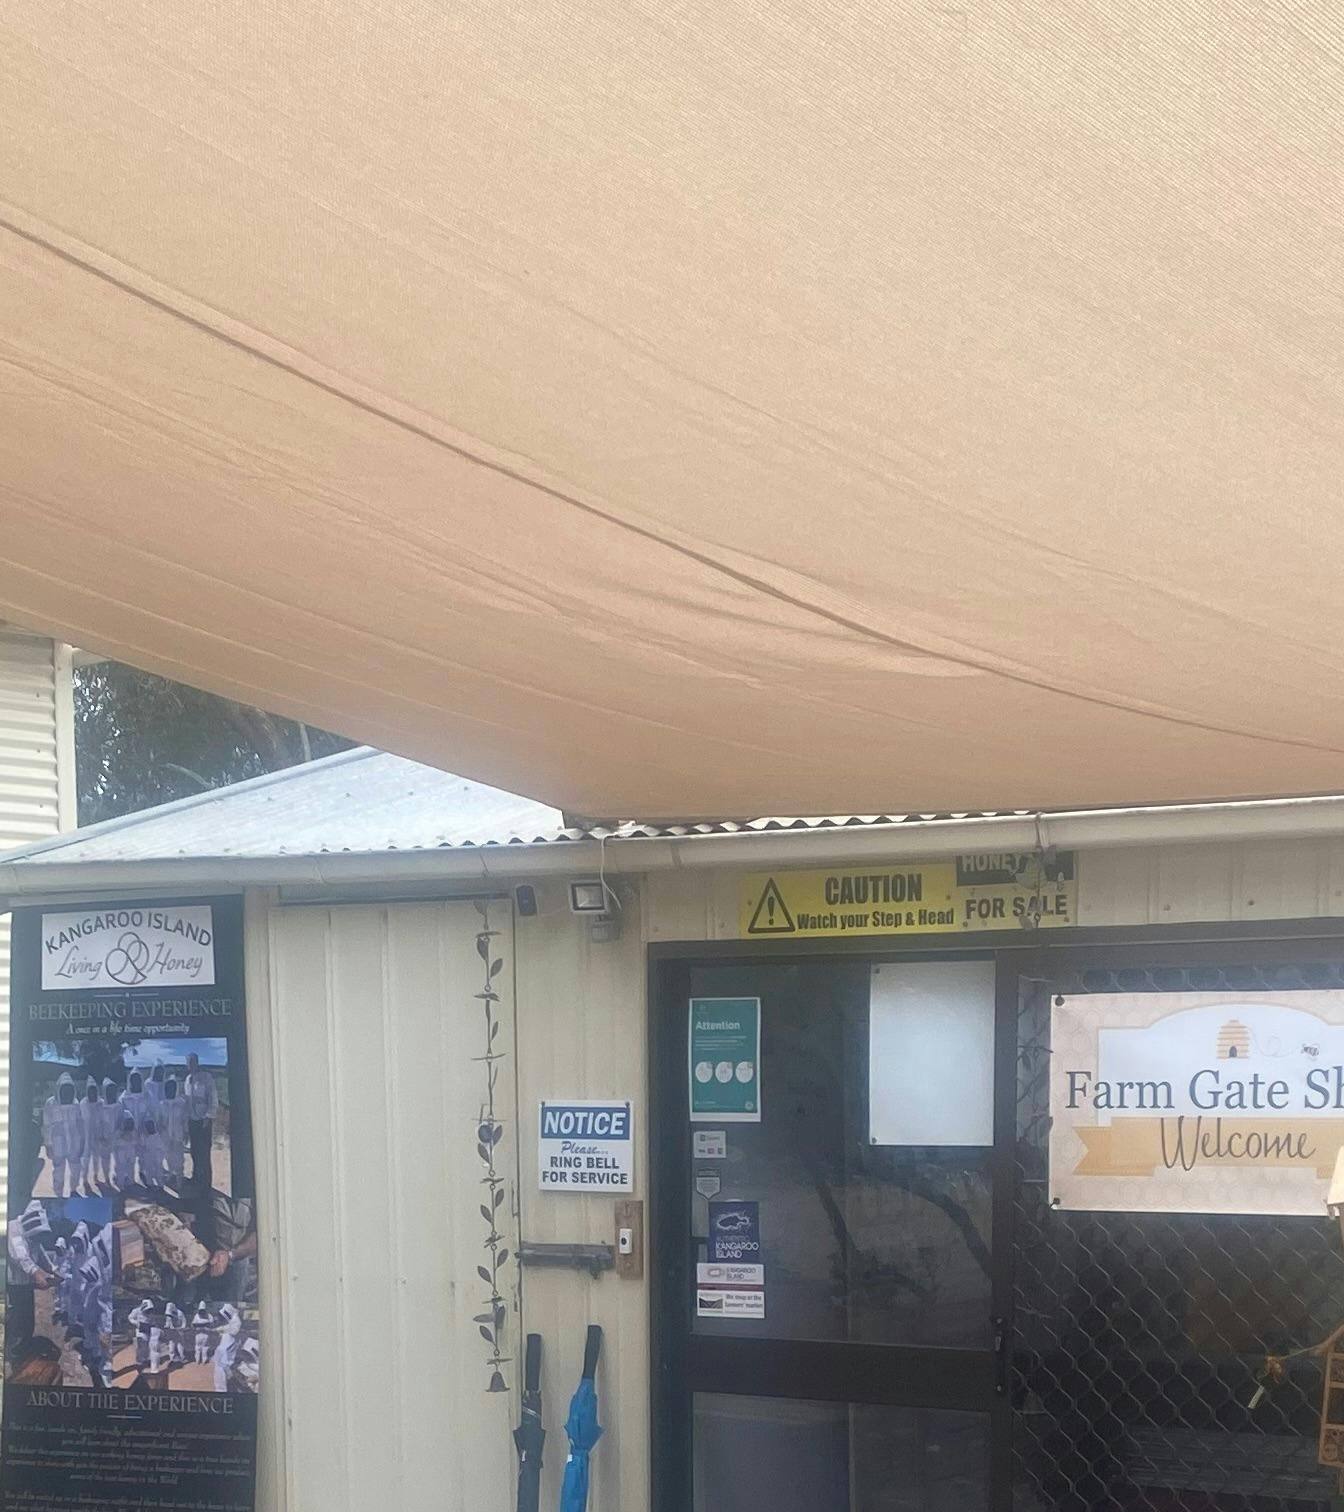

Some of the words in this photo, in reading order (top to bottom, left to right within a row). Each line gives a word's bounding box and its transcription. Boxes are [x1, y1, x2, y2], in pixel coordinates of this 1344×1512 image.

[824, 872, 923, 906] CAUTION
[796, 912, 838, 931] Watch
[840, 912, 870, 930] your
[872, 910, 903, 929] Step
[905, 910, 917, 926] &
[918, 907, 955, 926] Head
[965, 896, 1006, 920] FOR
[1012, 894, 1068, 917] SALE
[45, 911, 143, 954] KANGAROO
[147, 912, 212, 947] ISLAND
[55, 945, 103, 981] Living
[146, 941, 204, 979] Honey
[28, 1002, 127, 1021] BEEKEEPING
[132, 999, 232, 1019] EXPERIENCE
[696, 1021, 741, 1031] Attention
[1064, 1069, 1176, 1109] Farm
[1188, 1068, 1290, 1110] Gate
[543, 1111, 627, 1135] NOTICE
[1159, 1114, 1317, 1172] Welcome
[550, 1156, 582, 1169] RING
[586, 1157, 620, 1169] BELL
[542, 1171, 568, 1183] FOR
[571, 1171, 629, 1185] SERVICE
[715, 1240, 760, 1251] KANGAROO
[716, 1249, 743, 1259] ISLAND
[27, 1391, 83, 1409] ABOUT
[87, 1392, 119, 1410] THE
[124, 1394, 234, 1415] EXPERIENCE
